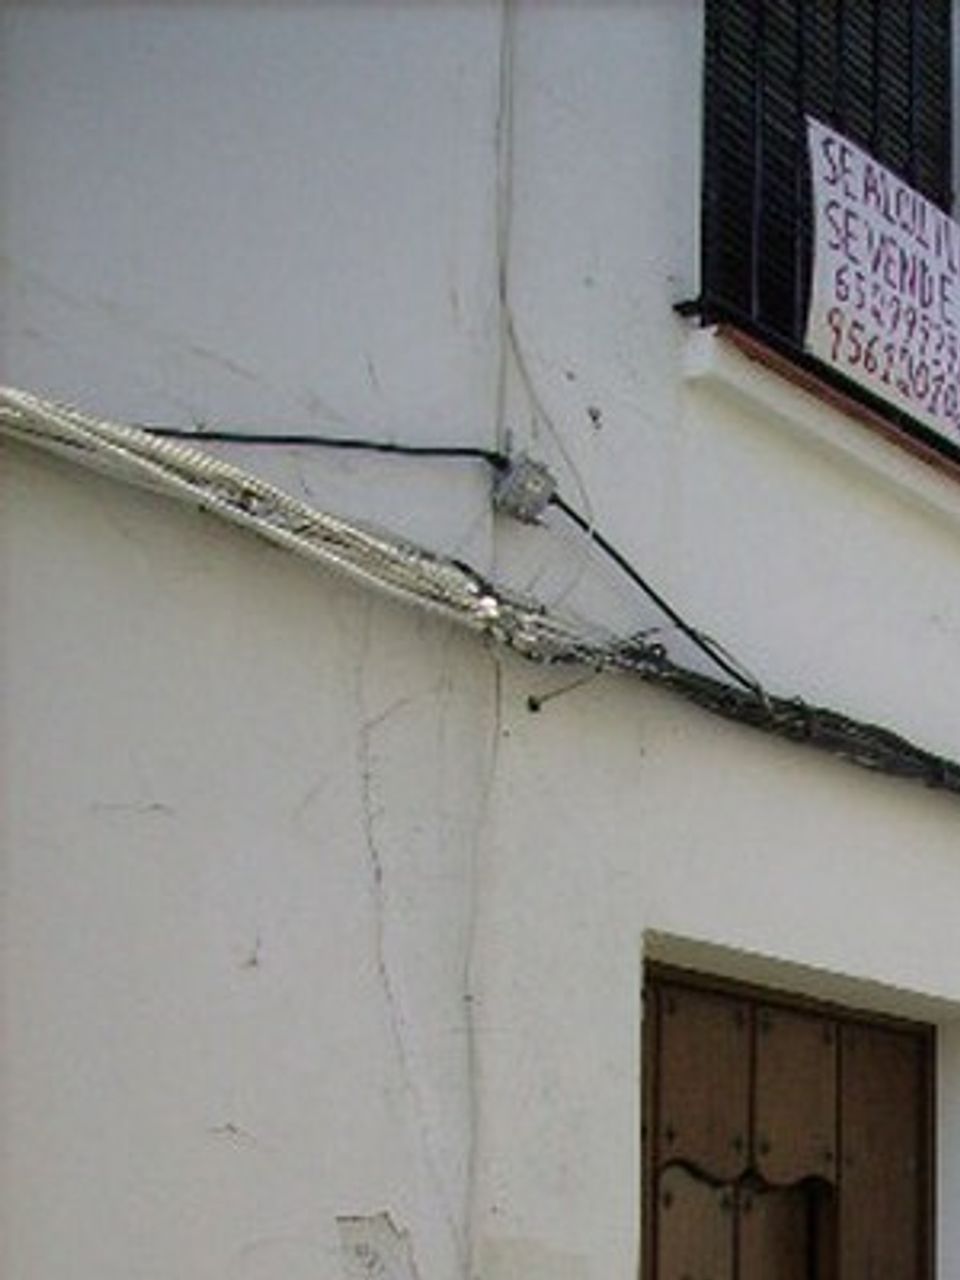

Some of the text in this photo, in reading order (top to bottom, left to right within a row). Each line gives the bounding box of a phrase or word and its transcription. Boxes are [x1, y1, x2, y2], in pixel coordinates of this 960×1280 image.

[822, 136, 858, 201] SE
[825, 200, 957, 328] SE VENDE
